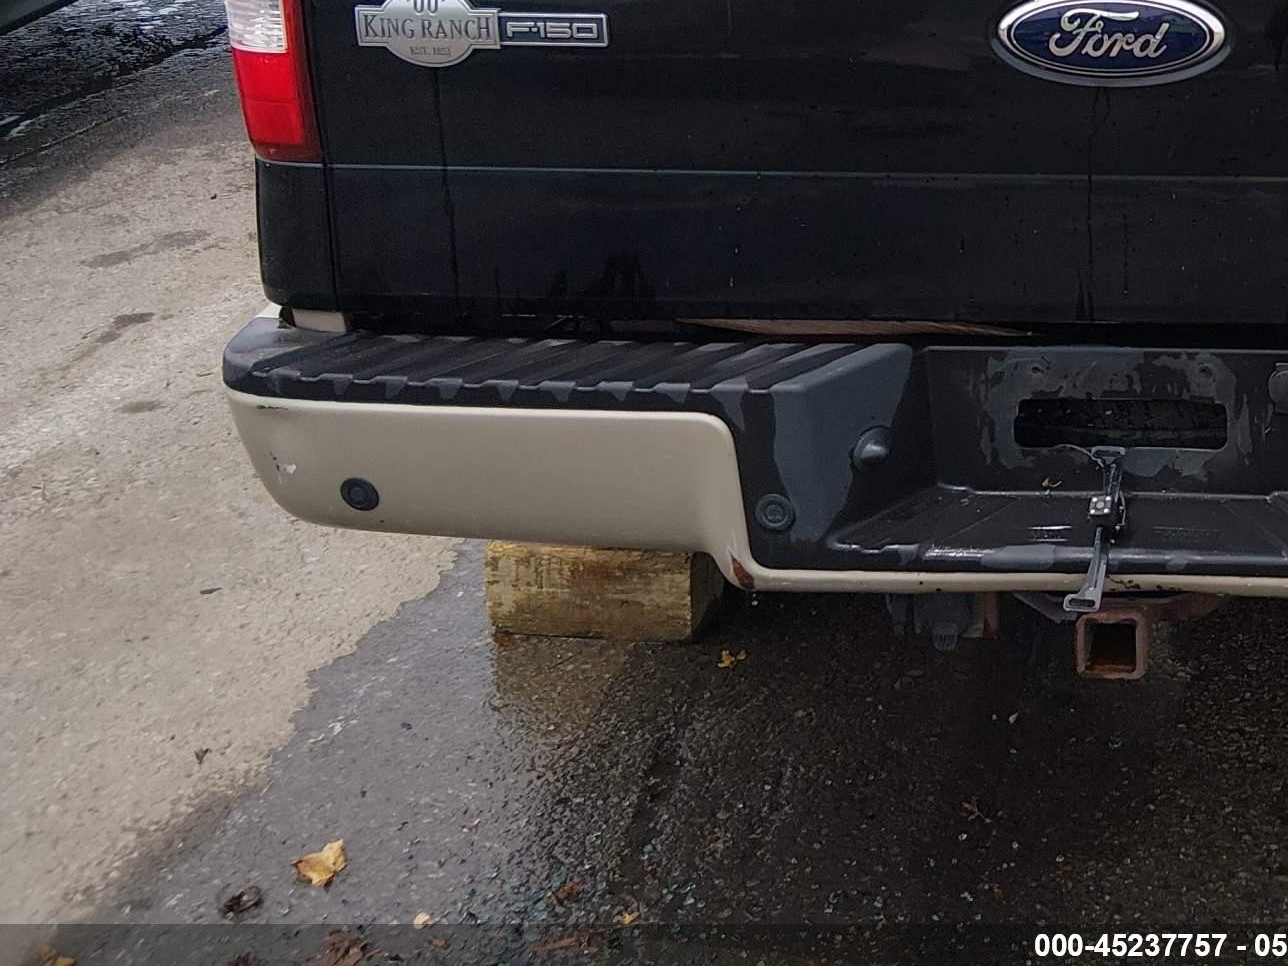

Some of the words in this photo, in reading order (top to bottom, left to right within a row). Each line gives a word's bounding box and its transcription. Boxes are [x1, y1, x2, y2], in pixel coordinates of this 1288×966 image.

[362, 14, 415, 40] KING
[420, 16, 492, 42] RANCH
[1048, 7, 1170, 58] Ford
